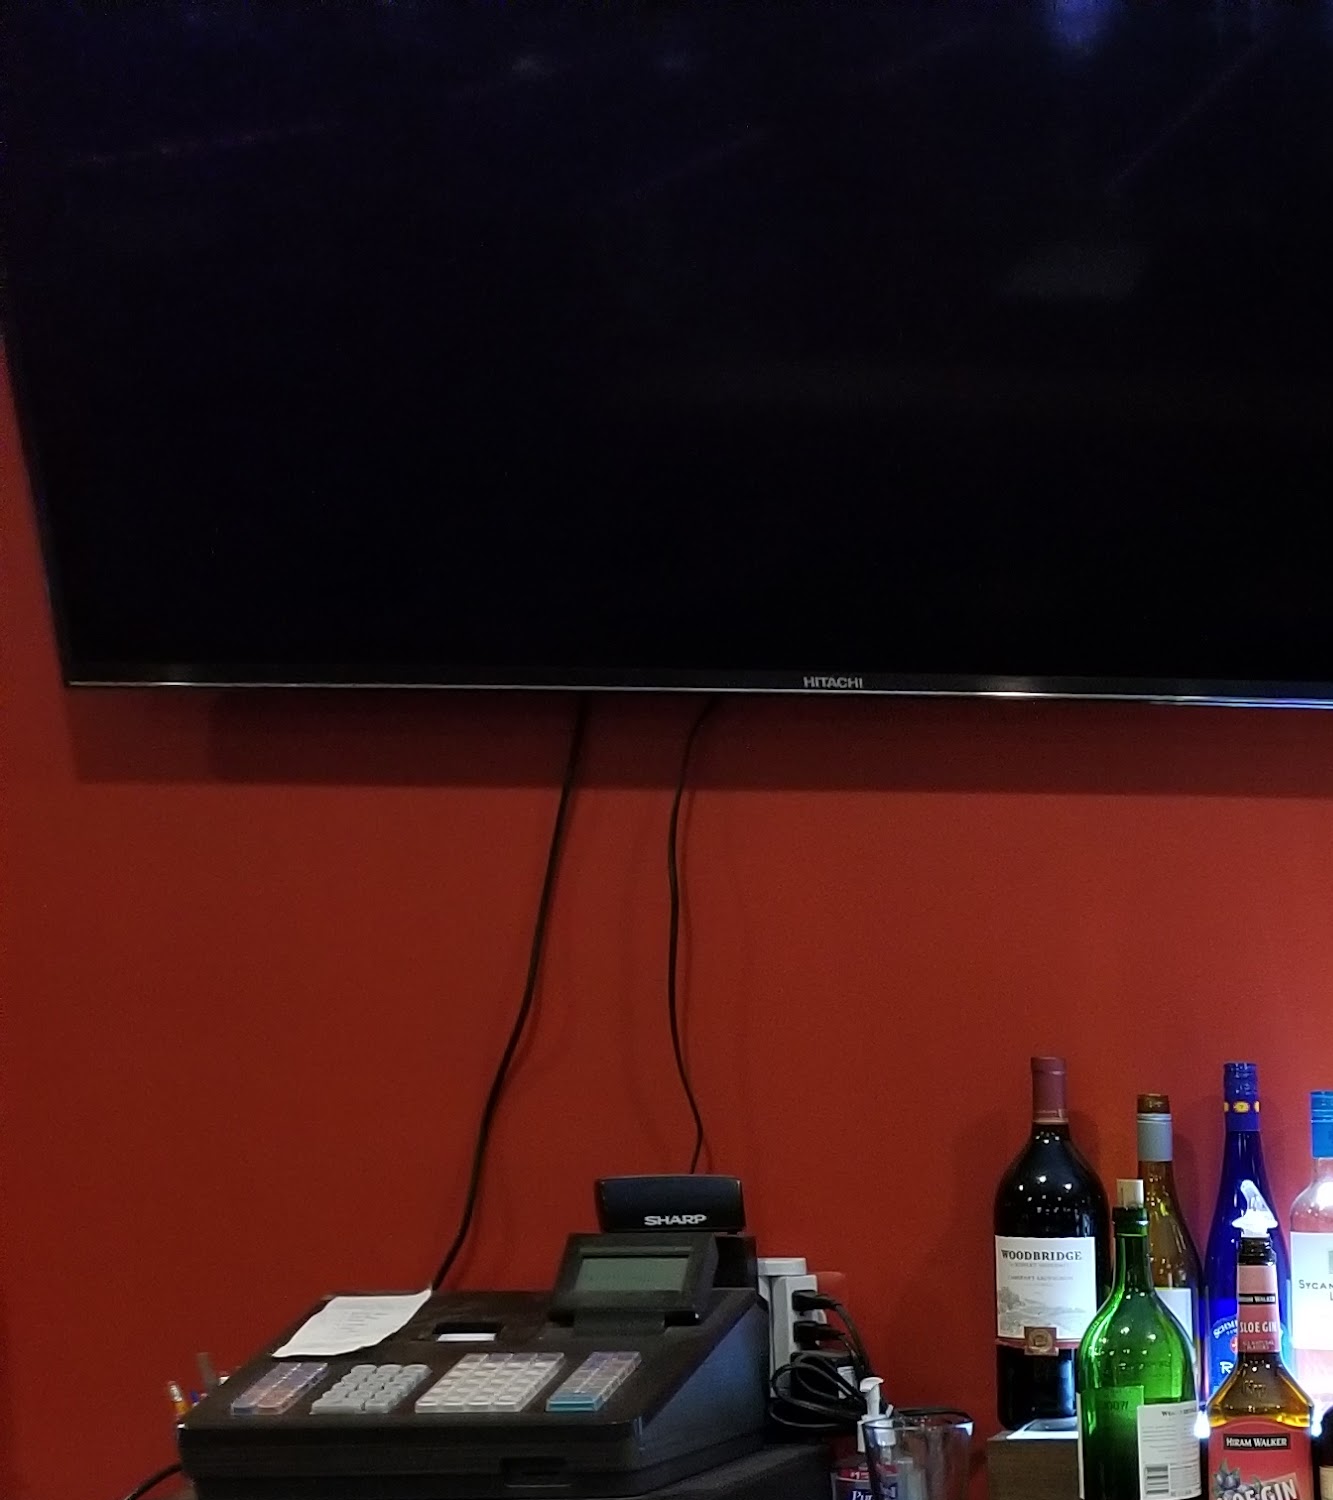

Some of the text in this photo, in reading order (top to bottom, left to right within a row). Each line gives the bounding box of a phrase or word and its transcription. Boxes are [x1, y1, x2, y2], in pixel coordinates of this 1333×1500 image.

[803, 676, 863, 689] HITACHI
[644, 1214, 707, 1226] SHARP
[1001, 1249, 1082, 1261] WOODBRIDGE
[1240, 1321, 1278, 1333] SLOE GIN
[1226, 1437, 1288, 1447] HIRAM WALKER
